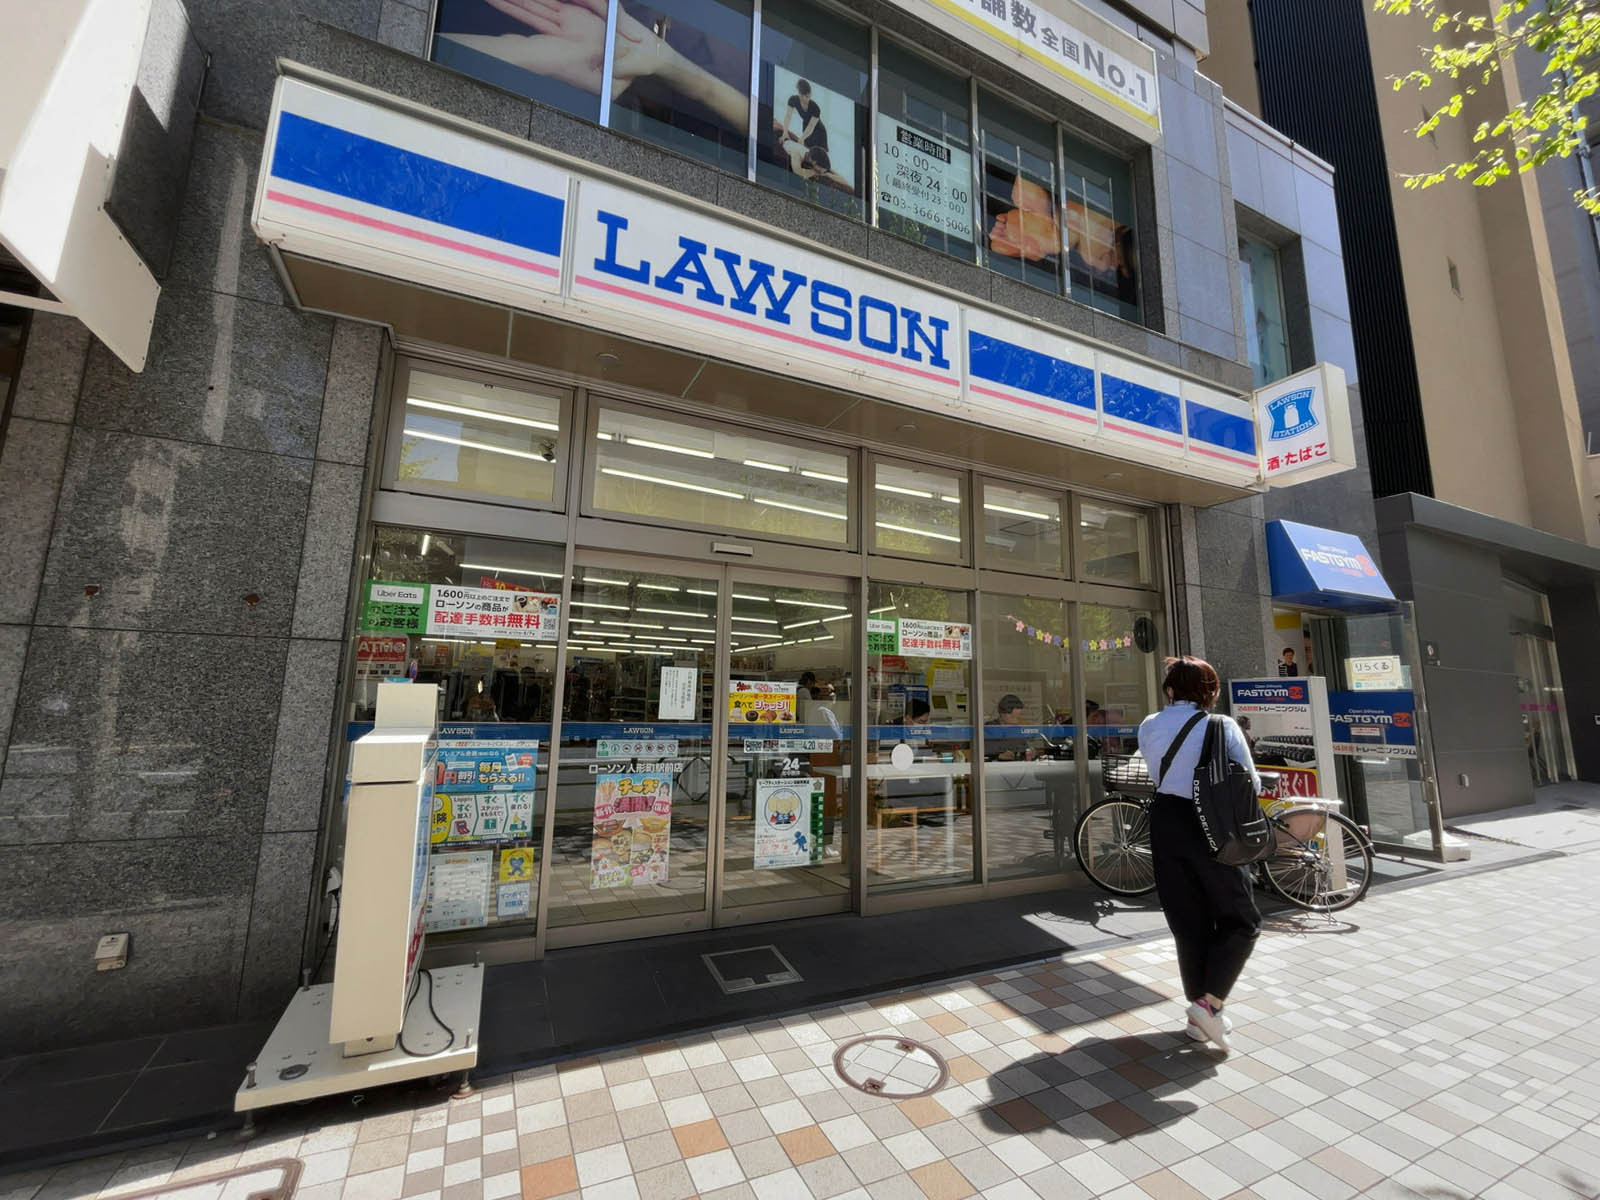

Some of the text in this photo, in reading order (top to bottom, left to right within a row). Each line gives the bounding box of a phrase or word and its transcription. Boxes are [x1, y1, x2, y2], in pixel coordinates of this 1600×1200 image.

[900, 128, 950, 162] 営業時間
[594, 209, 950, 370] LAWSON
[1269, 390, 1311, 411] LAWSON
[1273, 419, 1313, 438] STATION
[1267, 442, 1328, 471] 酒・たばこ
[376, 589, 418, 600] Uber Eats
[435, 599, 509, 612] ローソンの商品が
[368, 617, 420, 630] のお客様
[434, 610, 541, 630] 配達手数料無料
[358, 641, 393, 653] ATM
[1355, 662, 1389, 672] りらくる
[1237, 688, 1289, 697] FASTGYM
[589, 763, 684, 774] ローソン 人形町駅前店
[782, 758, 800, 771] 24
[618, 778, 660, 795] チーズ
[1193, 779, 1201, 805] DEAN
[1200, 815, 1219, 852] DELUCA
